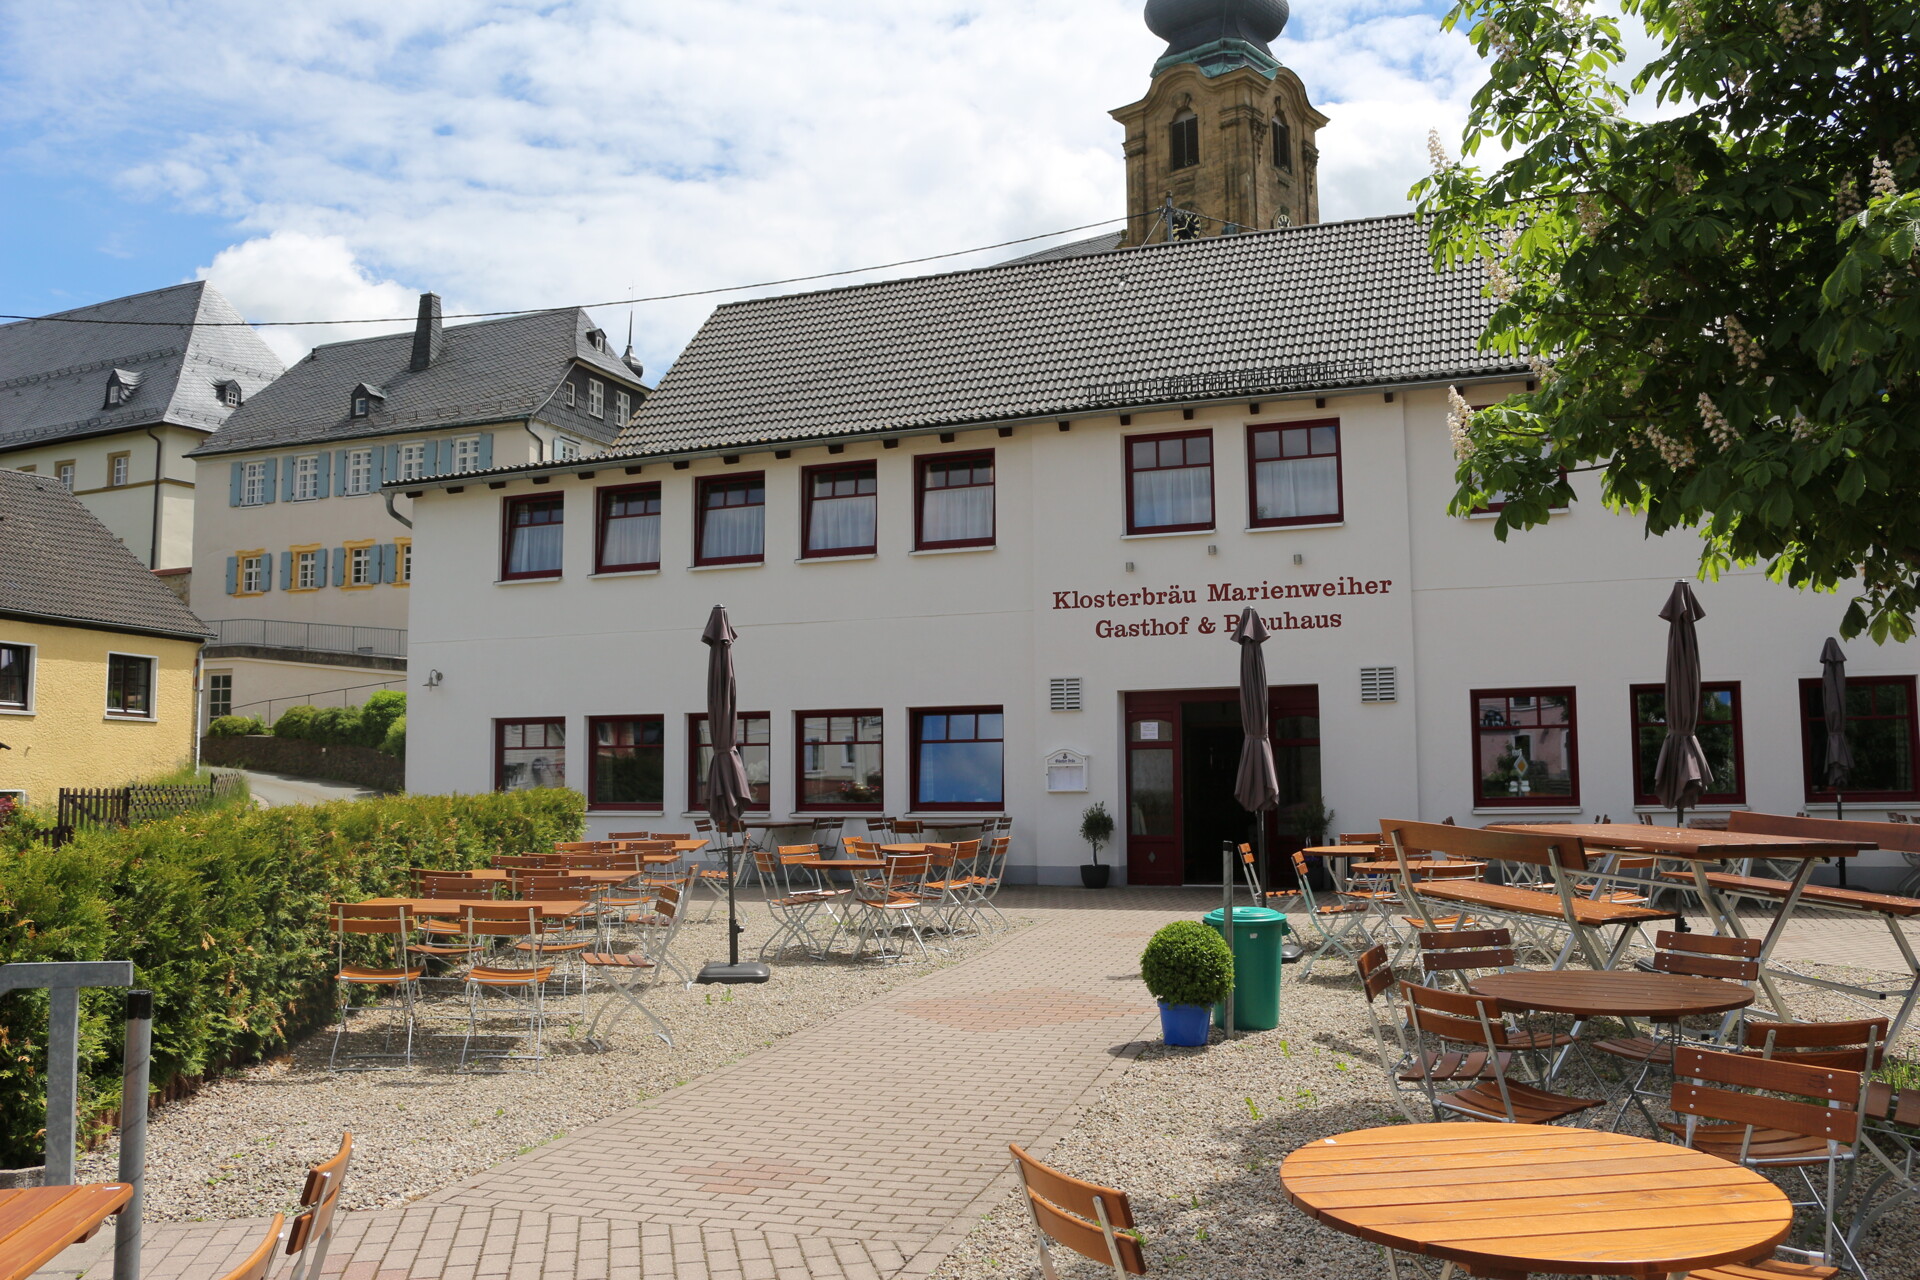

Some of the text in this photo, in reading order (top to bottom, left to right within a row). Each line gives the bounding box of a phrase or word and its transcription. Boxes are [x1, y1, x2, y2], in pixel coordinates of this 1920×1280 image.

[1052, 576, 1393, 610] Klosterbräu Marienweiher
[1095, 616, 1190, 638] Gasthof
[1197, 616, 1217, 635] &
